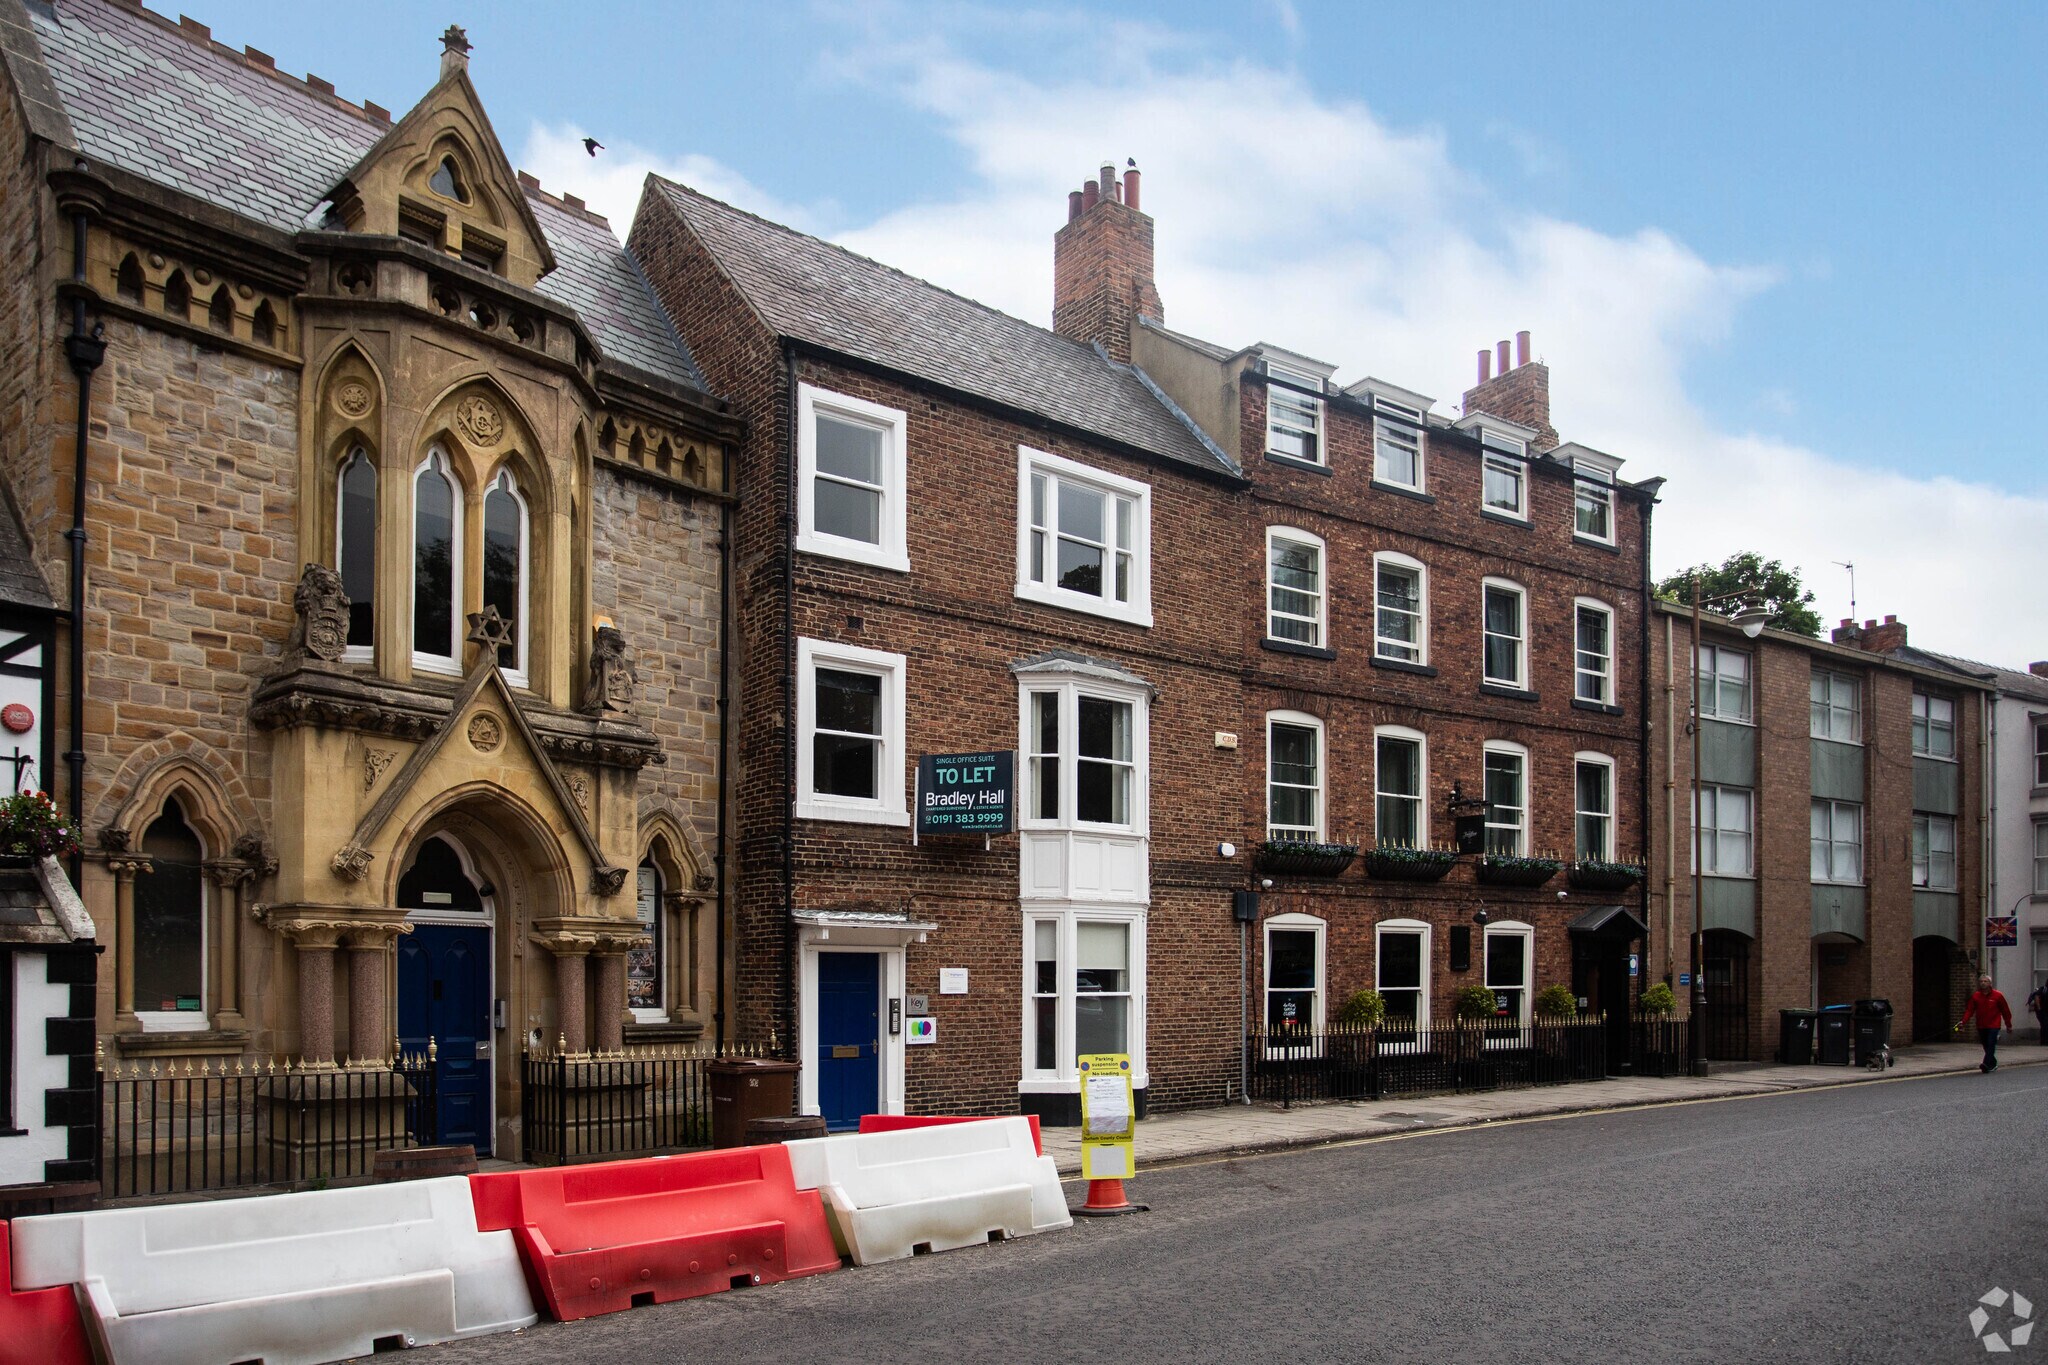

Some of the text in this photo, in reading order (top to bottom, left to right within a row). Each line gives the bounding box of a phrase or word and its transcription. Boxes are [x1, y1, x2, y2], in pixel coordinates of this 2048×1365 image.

[936, 766, 995, 784] TO LET
[926, 789, 1004, 810] Bradley Hall
[932, 815, 952, 824] 0191
[955, 814, 974, 823] 383
[977, 813, 1004, 822] 9999
[911, 998, 923, 1008] Key
